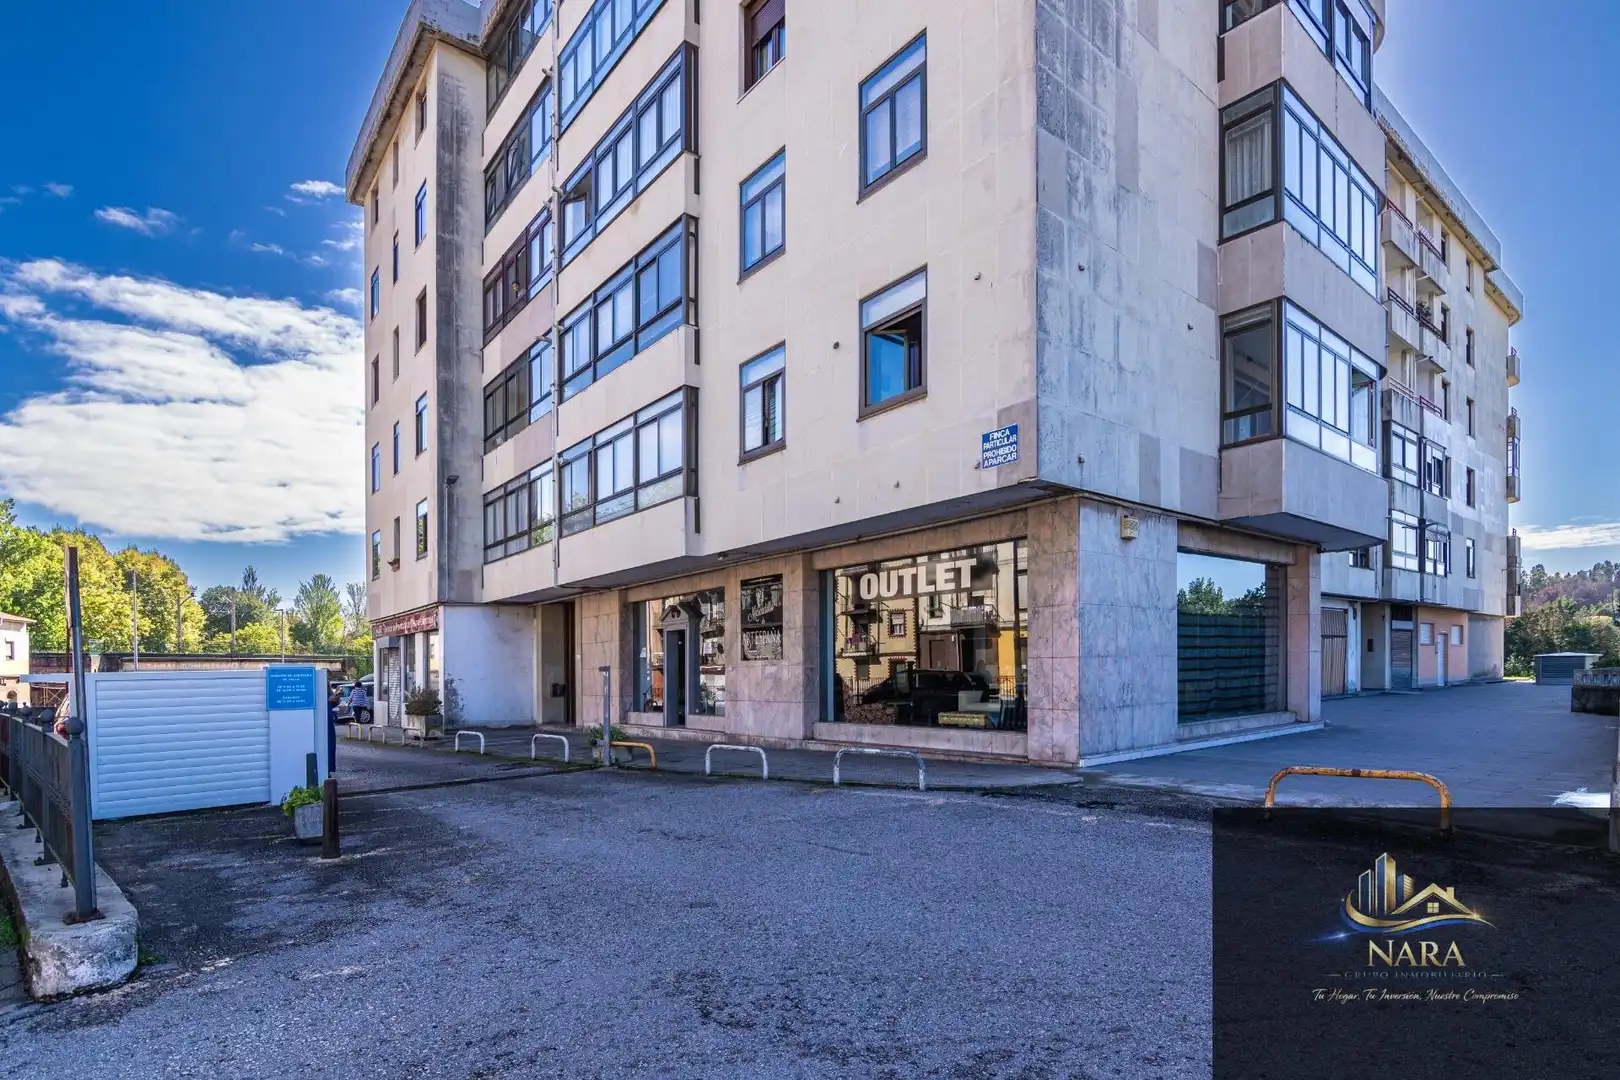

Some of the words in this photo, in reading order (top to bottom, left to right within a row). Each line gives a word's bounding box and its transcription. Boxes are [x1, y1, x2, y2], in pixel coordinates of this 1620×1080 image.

[983, 434, 1017, 450] PARTICULAR
[989, 428, 1010, 440] FINCA
[983, 444, 1017, 460] PROHIBIDO
[983, 452, 1017, 468] APARCAR
[859, 557, 977, 601] OUTLET
